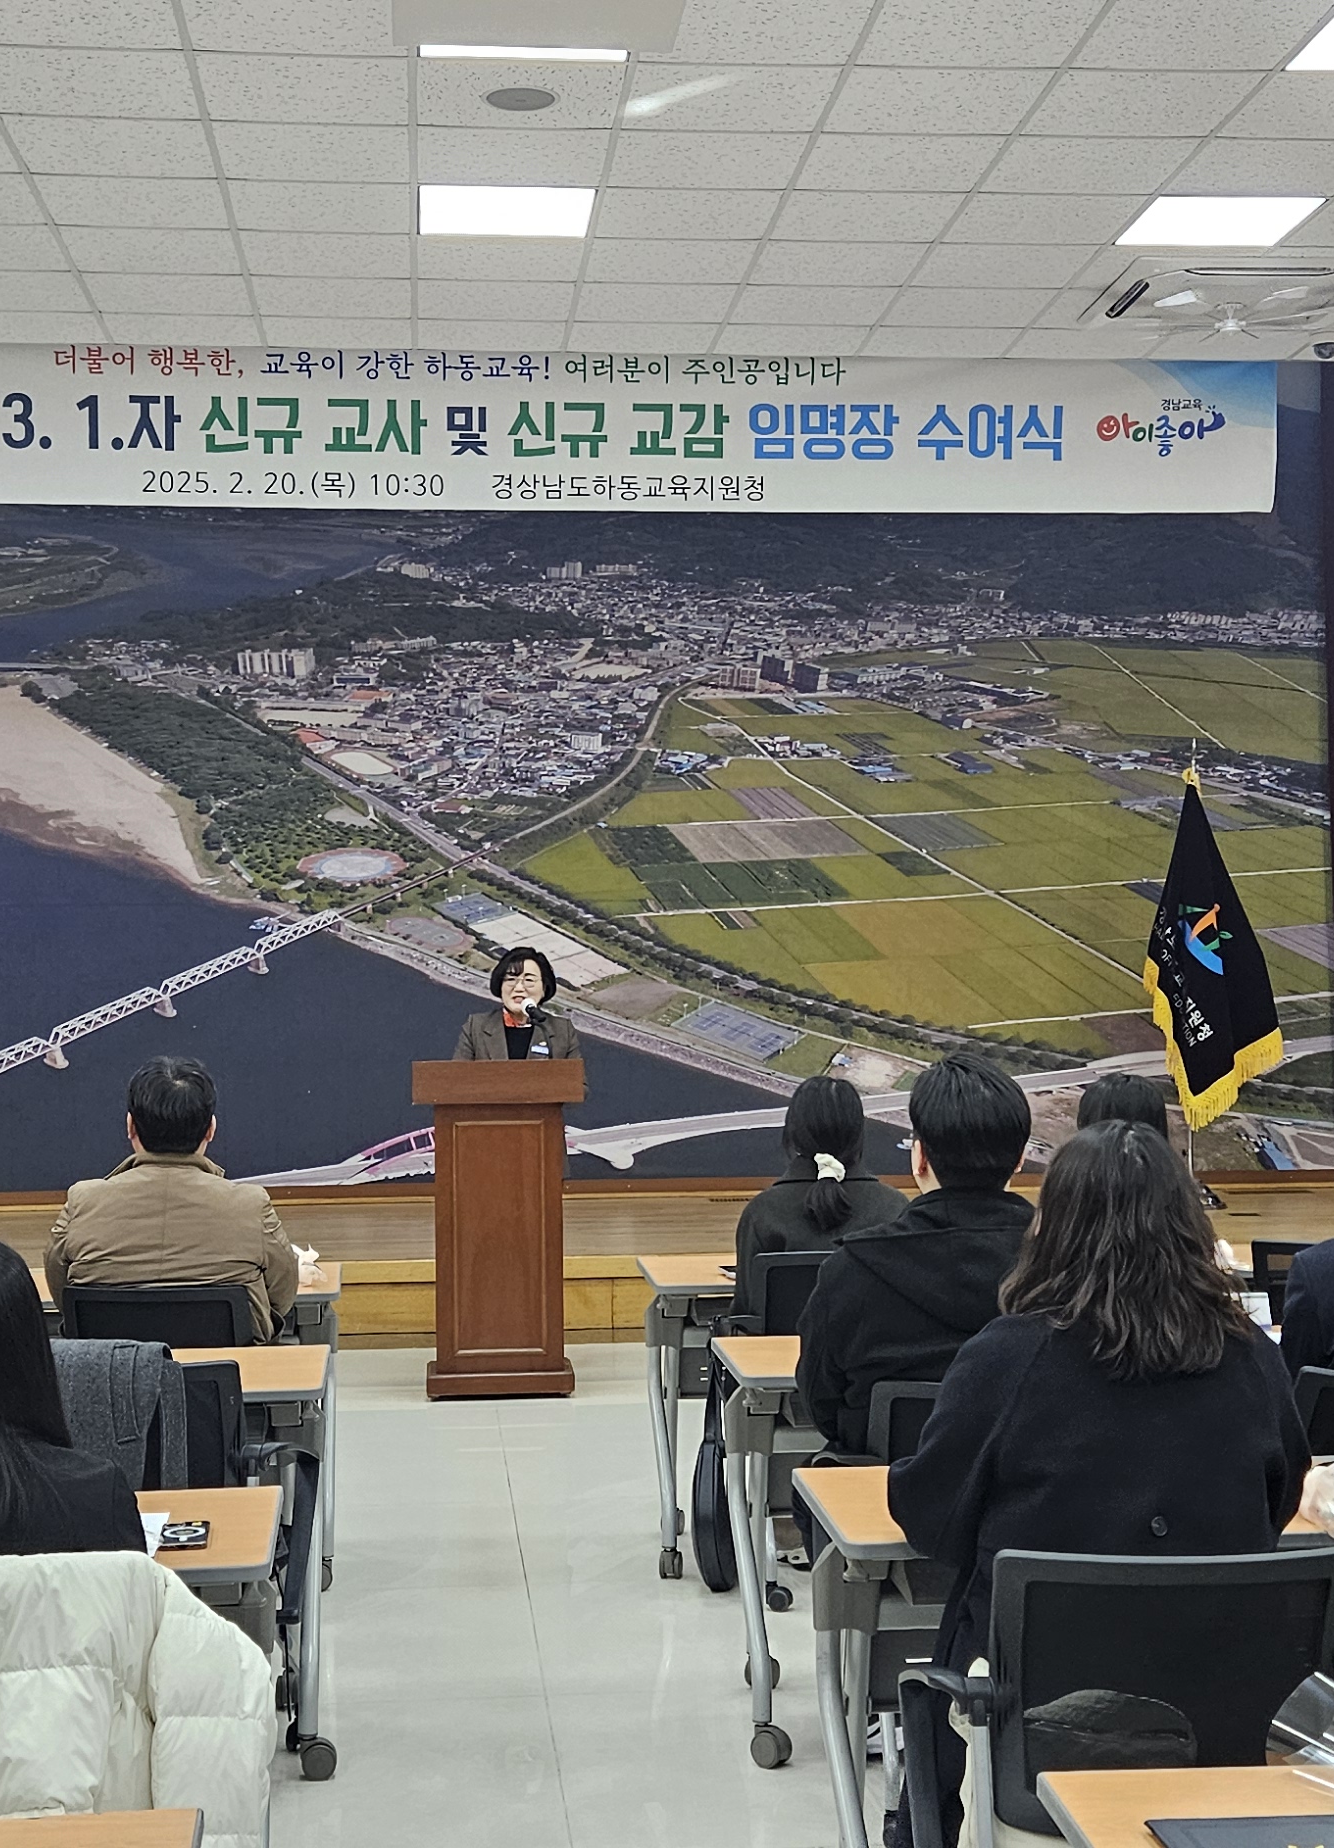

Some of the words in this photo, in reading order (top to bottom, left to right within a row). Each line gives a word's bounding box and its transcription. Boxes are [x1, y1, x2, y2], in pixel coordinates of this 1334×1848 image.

[54, 346, 136, 376] 더불어
[148, 347, 244, 379] 행복한,
[260, 348, 344, 380] 교육이
[357, 350, 414, 380] 강한
[424, 351, 551, 382] 하동교육!
[565, 353, 671, 385] 여러분이
[682, 355, 846, 387] 주인공입니다
[1160, 397, 1204, 412] 경남교육
[1, 391, 52, 449] 3.
[77, 393, 182, 452] 1.자
[199, 395, 302, 454] 신규
[324, 397, 428, 456] 교사
[446, 405, 488, 457] 및
[507, 401, 608, 459] 신규
[629, 402, 730, 460] 교감
[748, 403, 900, 461] 임명장
[917, 404, 1064, 462] 수여식
[1095, 411, 1226, 458] 아이좋아
[141, 469, 219, 495] 2025.
[229, 471, 254, 496] 2.
[264, 470, 356, 500] 20.(목)
[369, 472, 446, 497] 10:30
[490, 473, 766, 502] 경상남도하동교육지원청
